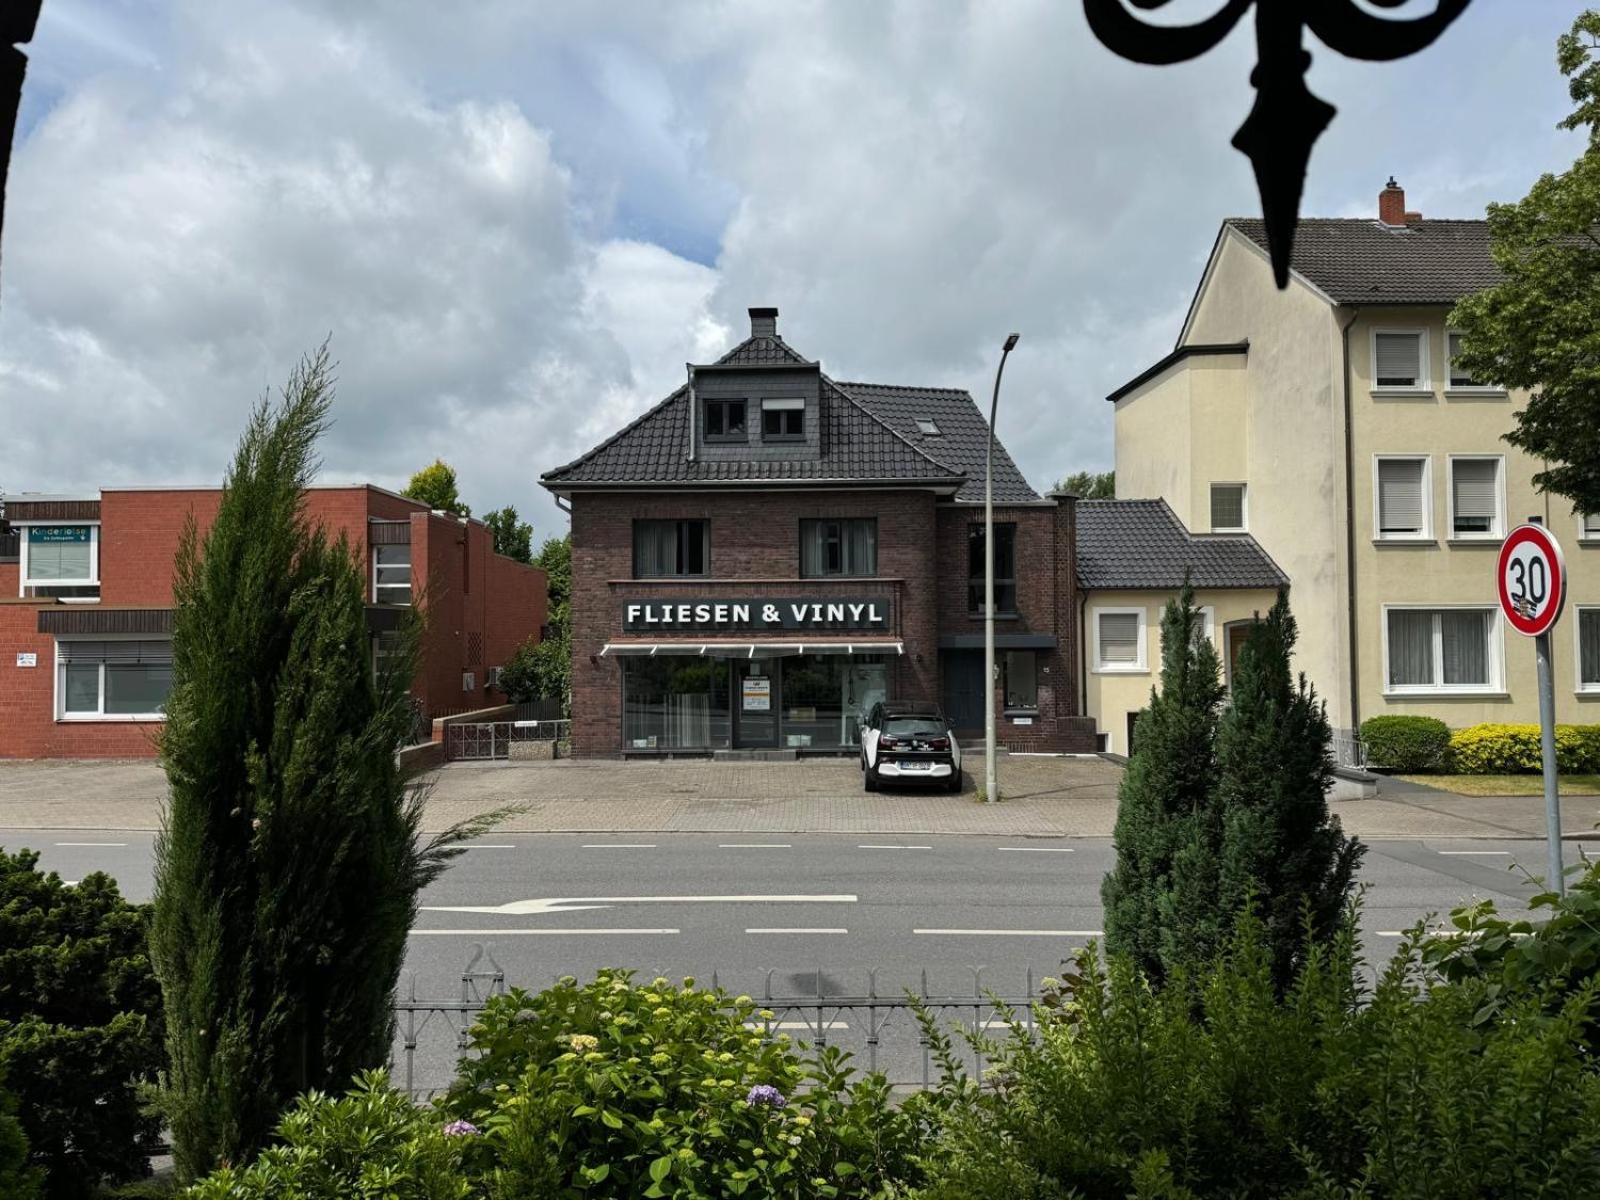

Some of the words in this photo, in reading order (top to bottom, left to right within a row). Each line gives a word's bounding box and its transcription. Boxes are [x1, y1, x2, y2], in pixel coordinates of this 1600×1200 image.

[32, 527, 86, 536] Kinderlotse
[1510, 556, 1545, 603] 30
[627, 604, 750, 623] FLIESEN
[761, 603, 781, 623] &
[791, 603, 883, 622] VINYL
